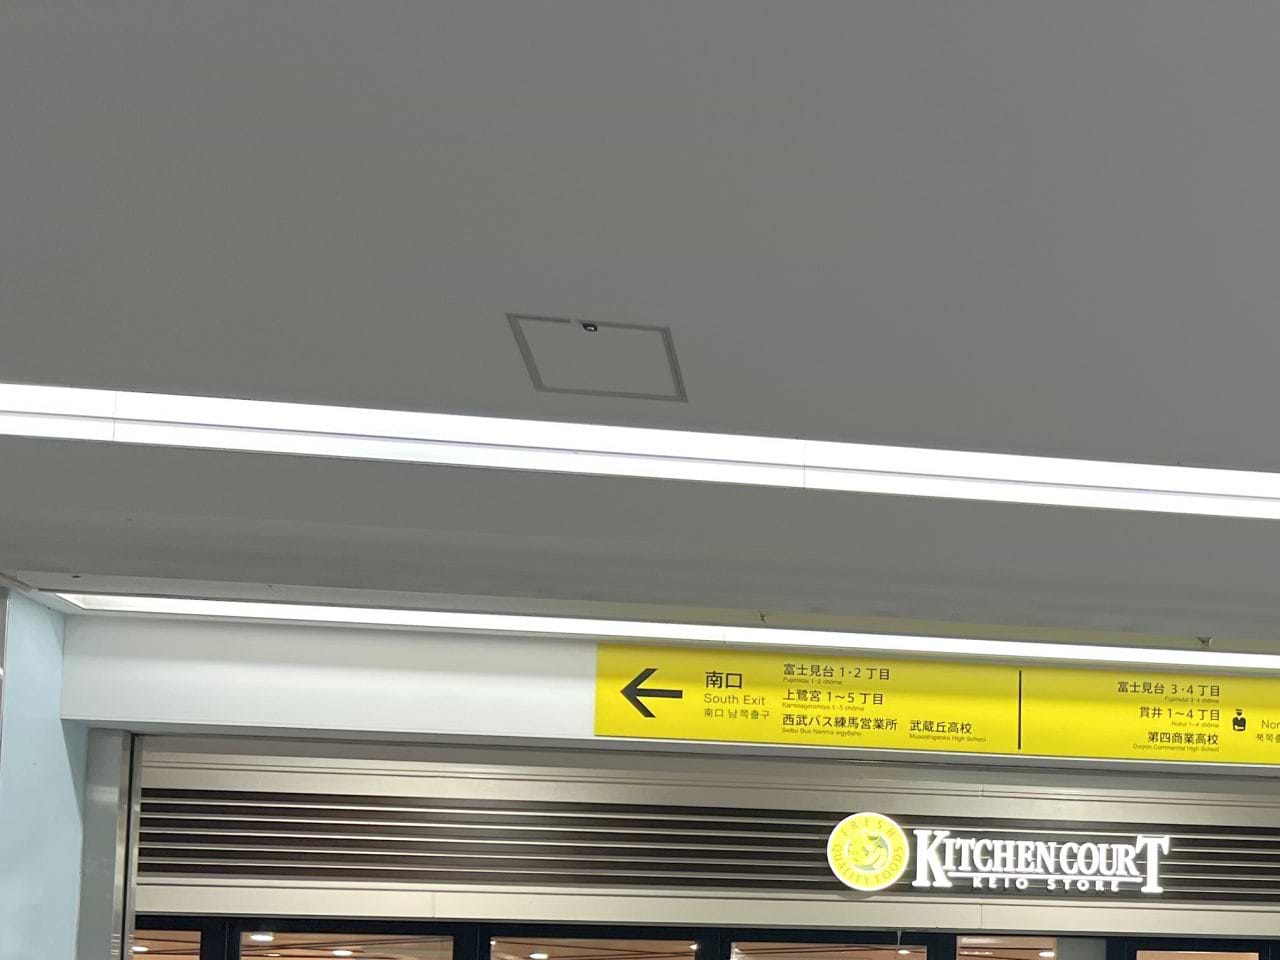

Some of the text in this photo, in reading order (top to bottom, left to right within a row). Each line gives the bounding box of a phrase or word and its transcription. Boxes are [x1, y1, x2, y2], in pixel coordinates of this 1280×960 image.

[705, 671, 742, 689] 南口
[704, 693, 765, 706] South Exit
[782, 713, 897, 731] 西武バス練馬営業所
[910, 719, 972, 734] 武蔵丘高校
[1148, 731, 1219, 745] 第四商業高校
[841, 816, 896, 837] FRESH
[972, 876, 1119, 892] KEIO STORE
